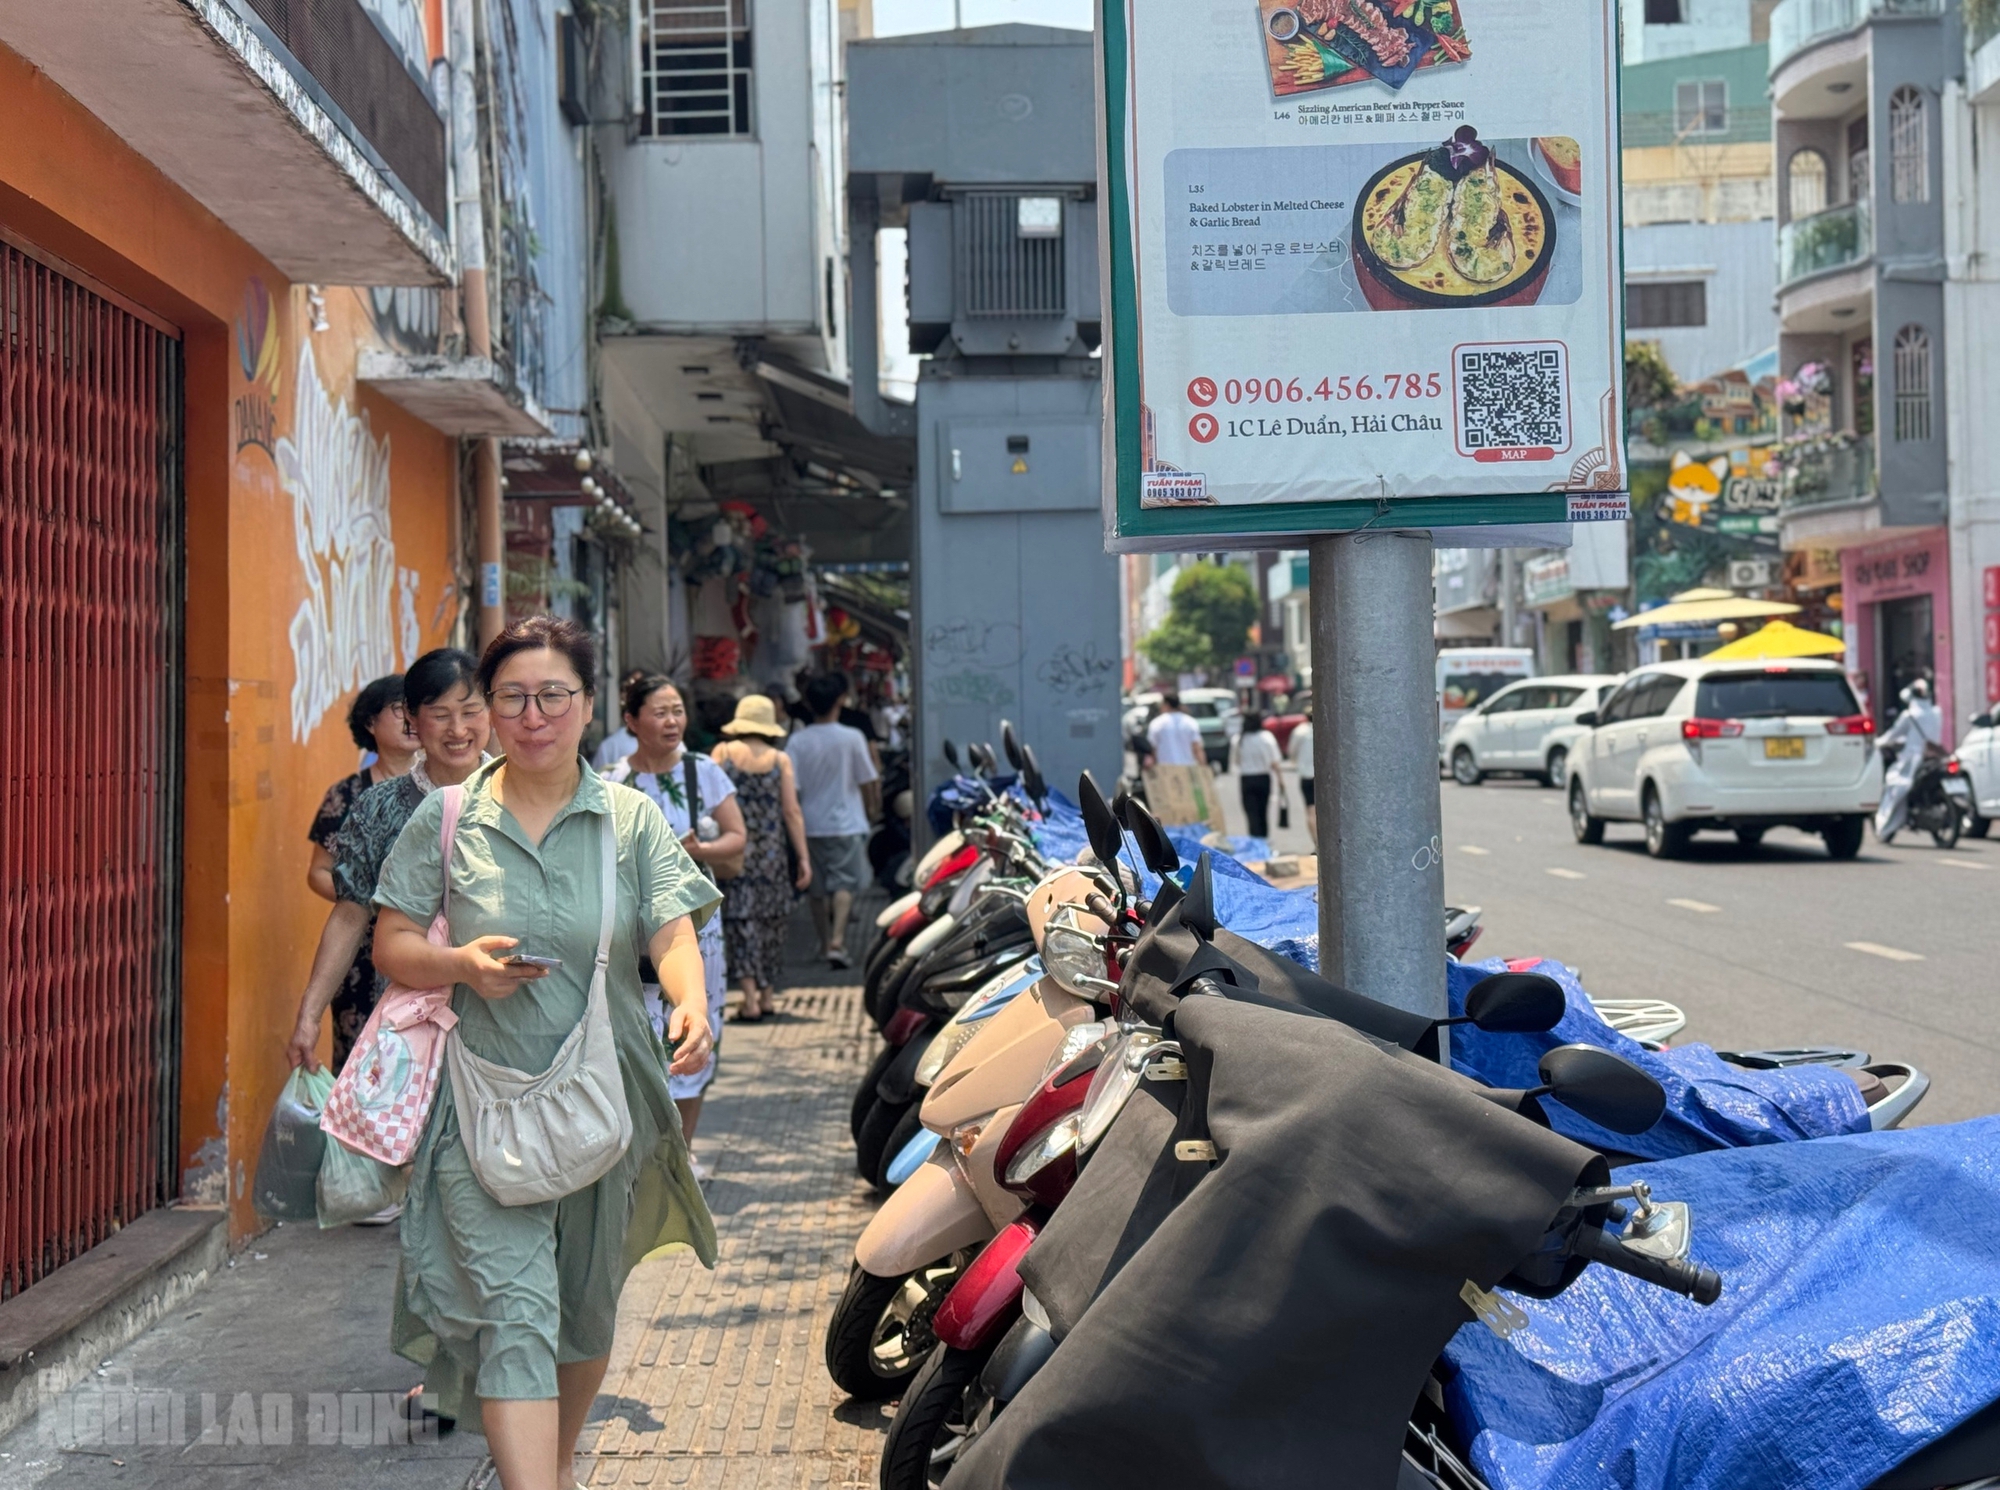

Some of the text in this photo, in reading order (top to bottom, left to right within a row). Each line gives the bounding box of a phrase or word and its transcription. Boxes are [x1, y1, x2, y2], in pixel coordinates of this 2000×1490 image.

[1298, 100, 1465, 114] Sizzling American Beef with Pepper Sauce
[1274, 112, 1290, 120] L46
[1298, 114, 1341, 125] 아메리칸
[1189, 185, 1205, 193] L35
[1189, 199, 1345, 213] Baked Lobster in Melted Cheese
[1190, 218, 1198, 227] &
[1200, 217, 1230, 227] Garlic
[1231, 216, 1261, 227] Bread
[1192, 244, 1229, 257] 치즈를
[1261, 243, 1286, 255] 구운
[1289, 241, 1341, 254] 로브스터
[1191, 261, 1199, 271] &
[1224, 372, 1442, 405] 0906.456.785
[1228, 413, 1443, 438] 1C Lê Duẩn, Hải Châu
[1501, 450, 1527, 459] MAP
[1147, 488, 1202, 497] 0905 363 077
[1571, 511, 1591, 520] 0905
[1611, 510, 1627, 519] 077
[1411, 834, 1442, 871] 08
